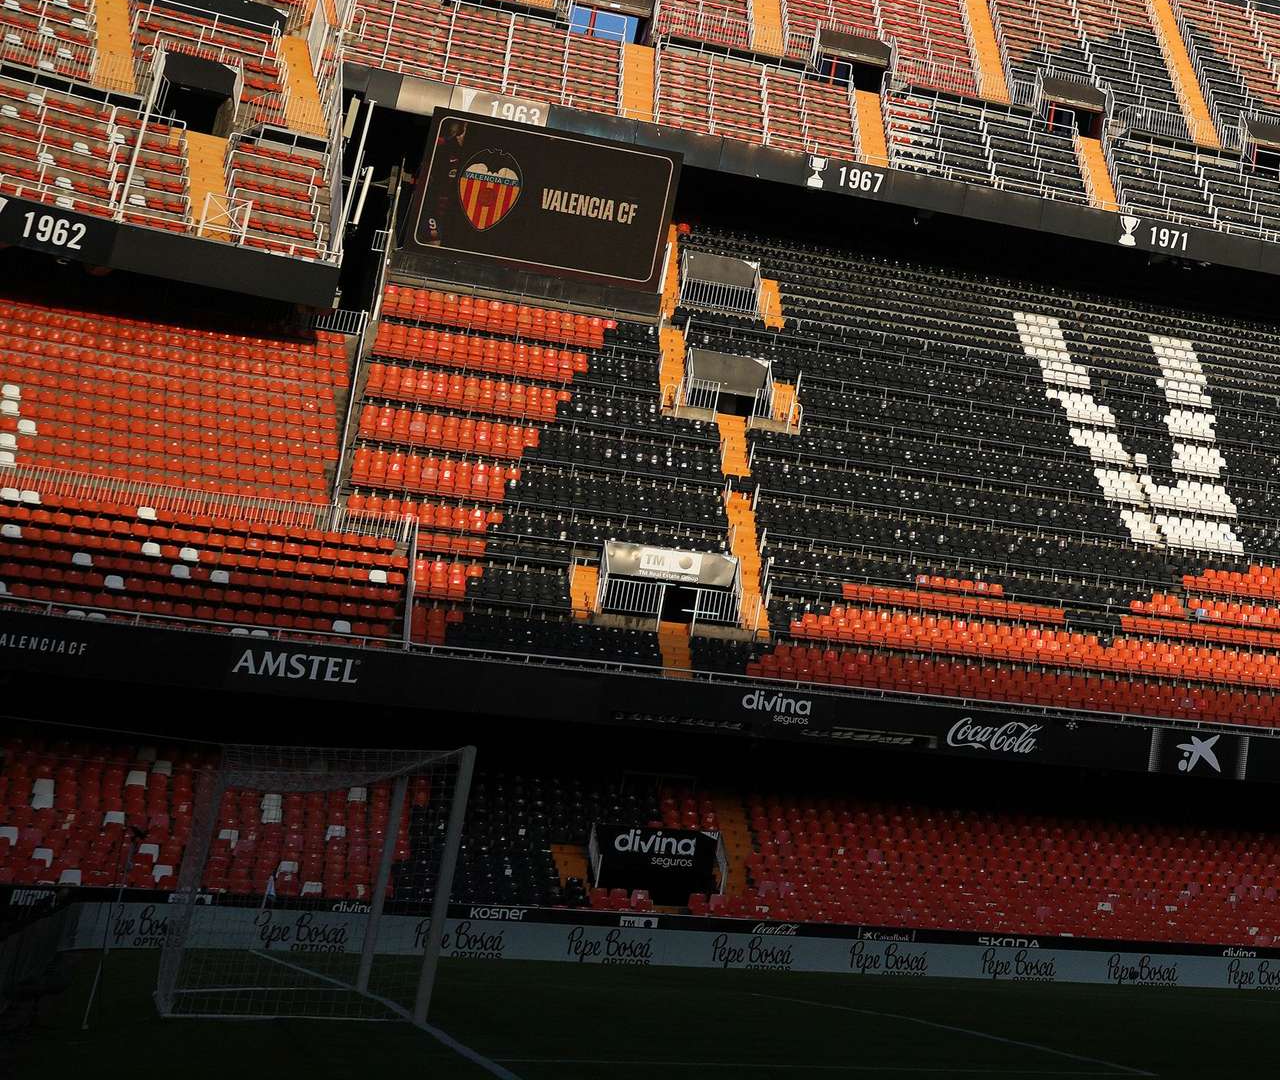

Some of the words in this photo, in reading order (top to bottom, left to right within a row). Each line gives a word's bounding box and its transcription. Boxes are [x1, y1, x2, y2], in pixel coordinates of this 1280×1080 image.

[838, 165, 884, 194] 1967
[542, 188, 614, 222] VALENCIA
[617, 203, 638, 225] CF
[23, 211, 87, 250] 1962
[1149, 226, 1189, 252] 1971
[645, 554, 665, 567] TM
[681, 574, 699, 584] Group
[232, 650, 359, 685] AMSTEL
[742, 689, 812, 717] divina
[772, 713, 809, 726] seguros
[614, 828, 697, 856] divina
[650, 856, 693, 868] seguros
[254, 910, 290, 949] Pepe
[296, 912, 349, 945] Boscá
[414, 918, 449, 949] Pee
[455, 920, 505, 952] Boscá
[567, 926, 601, 963] Pepe
[605, 928, 652, 958] Boscá
[712, 933, 744, 970] Pepe
[747, 935, 795, 965] Boscá
[850, 940, 881, 976] Pepe
[884, 942, 928, 971] Boscá
[981, 946, 1012, 980] Pepe
[1014, 948, 1057, 977] Boscá
[1138, 954, 1178, 982] Boscá
[1227, 958, 1255, 989] Pepe
